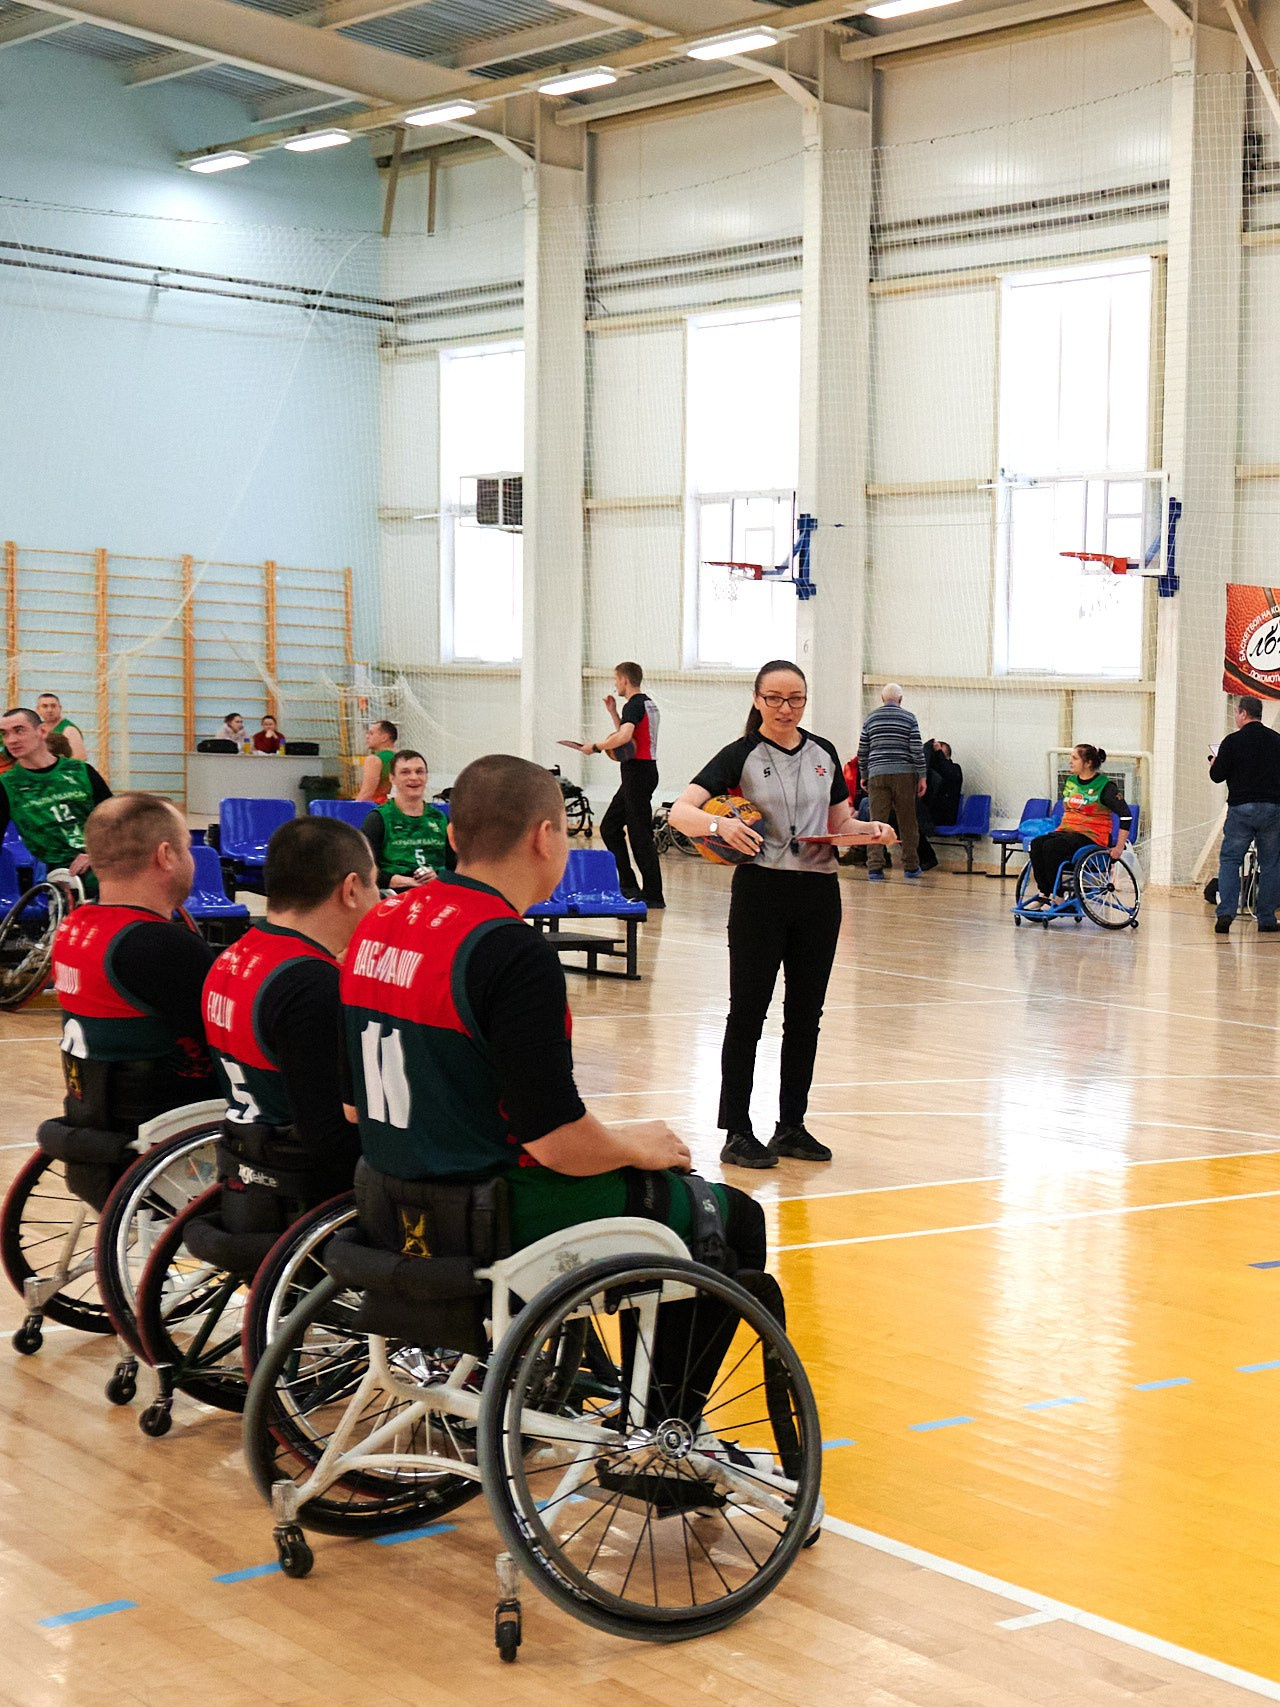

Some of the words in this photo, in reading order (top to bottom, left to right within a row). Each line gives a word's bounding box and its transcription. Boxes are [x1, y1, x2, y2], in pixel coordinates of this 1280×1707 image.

[50, 803, 76, 823] 12
[415, 849, 426, 865] 5
[220, 1057, 260, 1124] 5
[361, 1020, 411, 1129] 11
